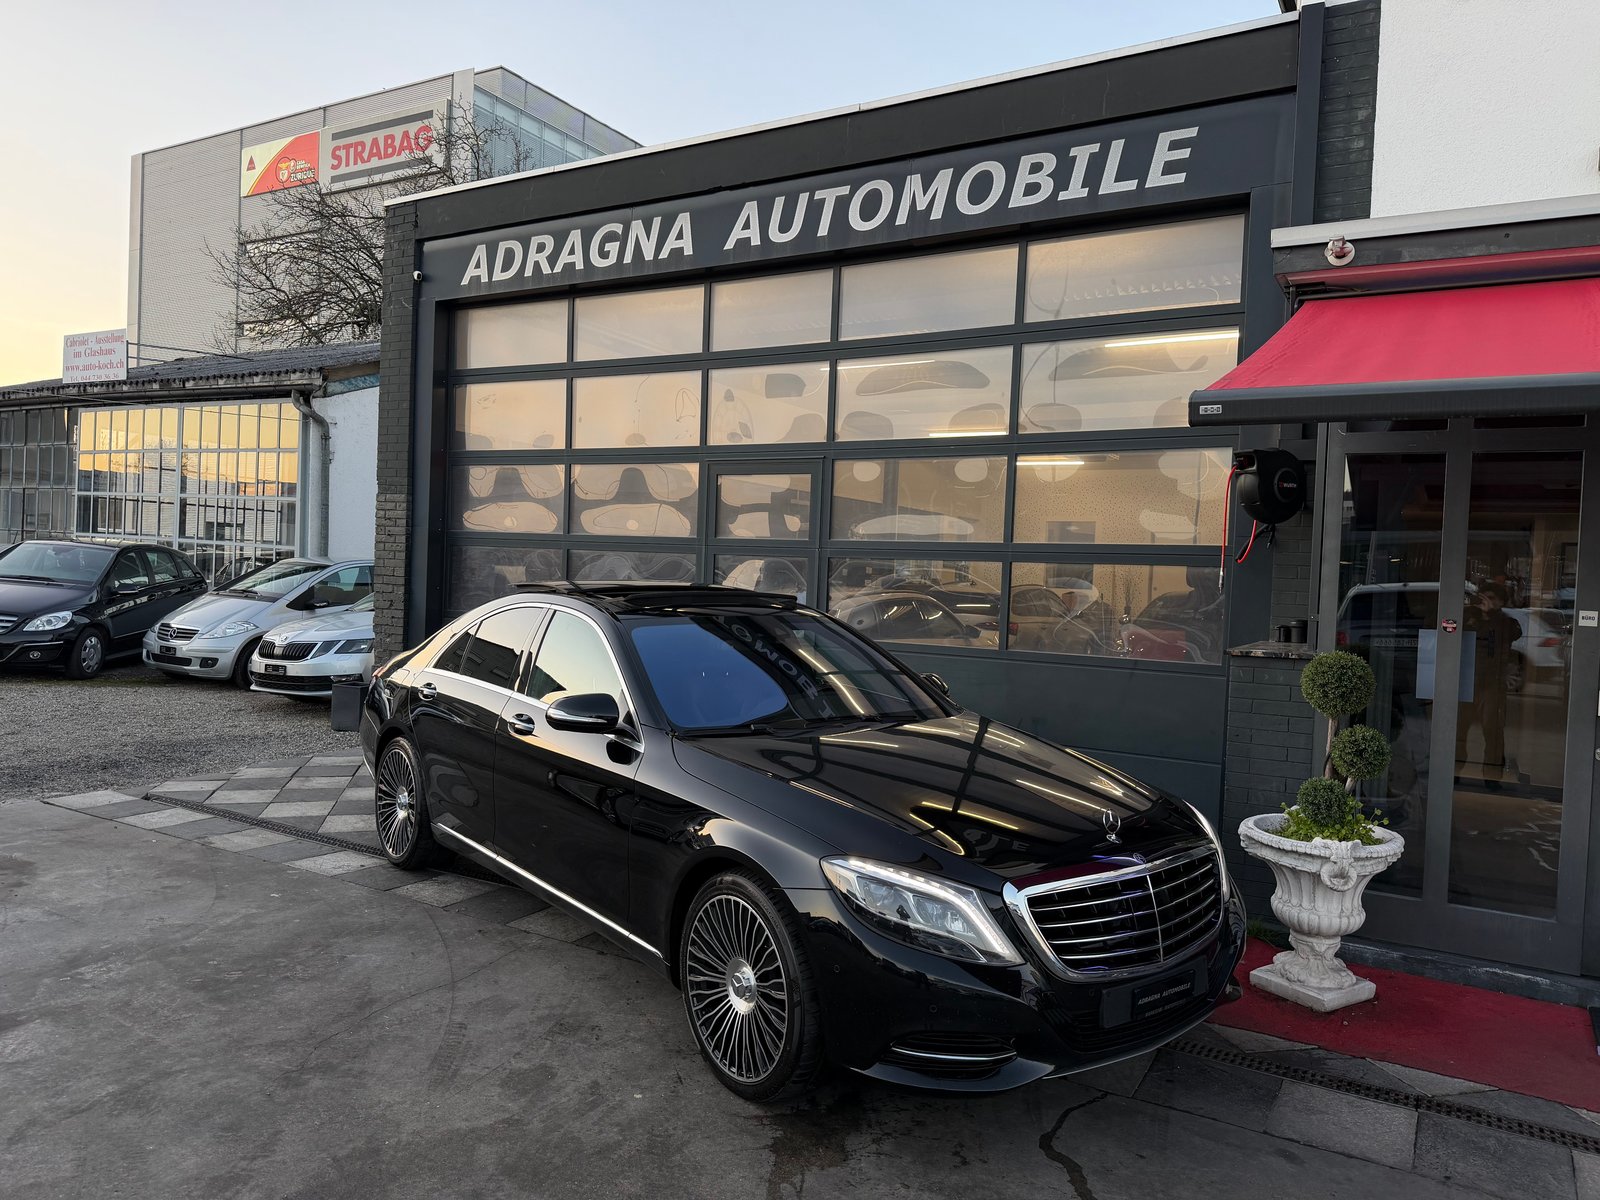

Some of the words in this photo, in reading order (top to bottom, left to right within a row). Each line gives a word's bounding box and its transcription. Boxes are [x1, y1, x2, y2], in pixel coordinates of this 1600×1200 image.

[330, 125, 433, 170] STRABAG
[460, 211, 694, 286] ADRAGNA
[723, 126, 1200, 251] AUTOMOBILE
[66, 336, 89, 347] Cabriolet
[73, 349, 81, 358] im
[84, 347, 116, 357] Glashaus
[65, 359, 124, 371] www.auto-koch.ch
